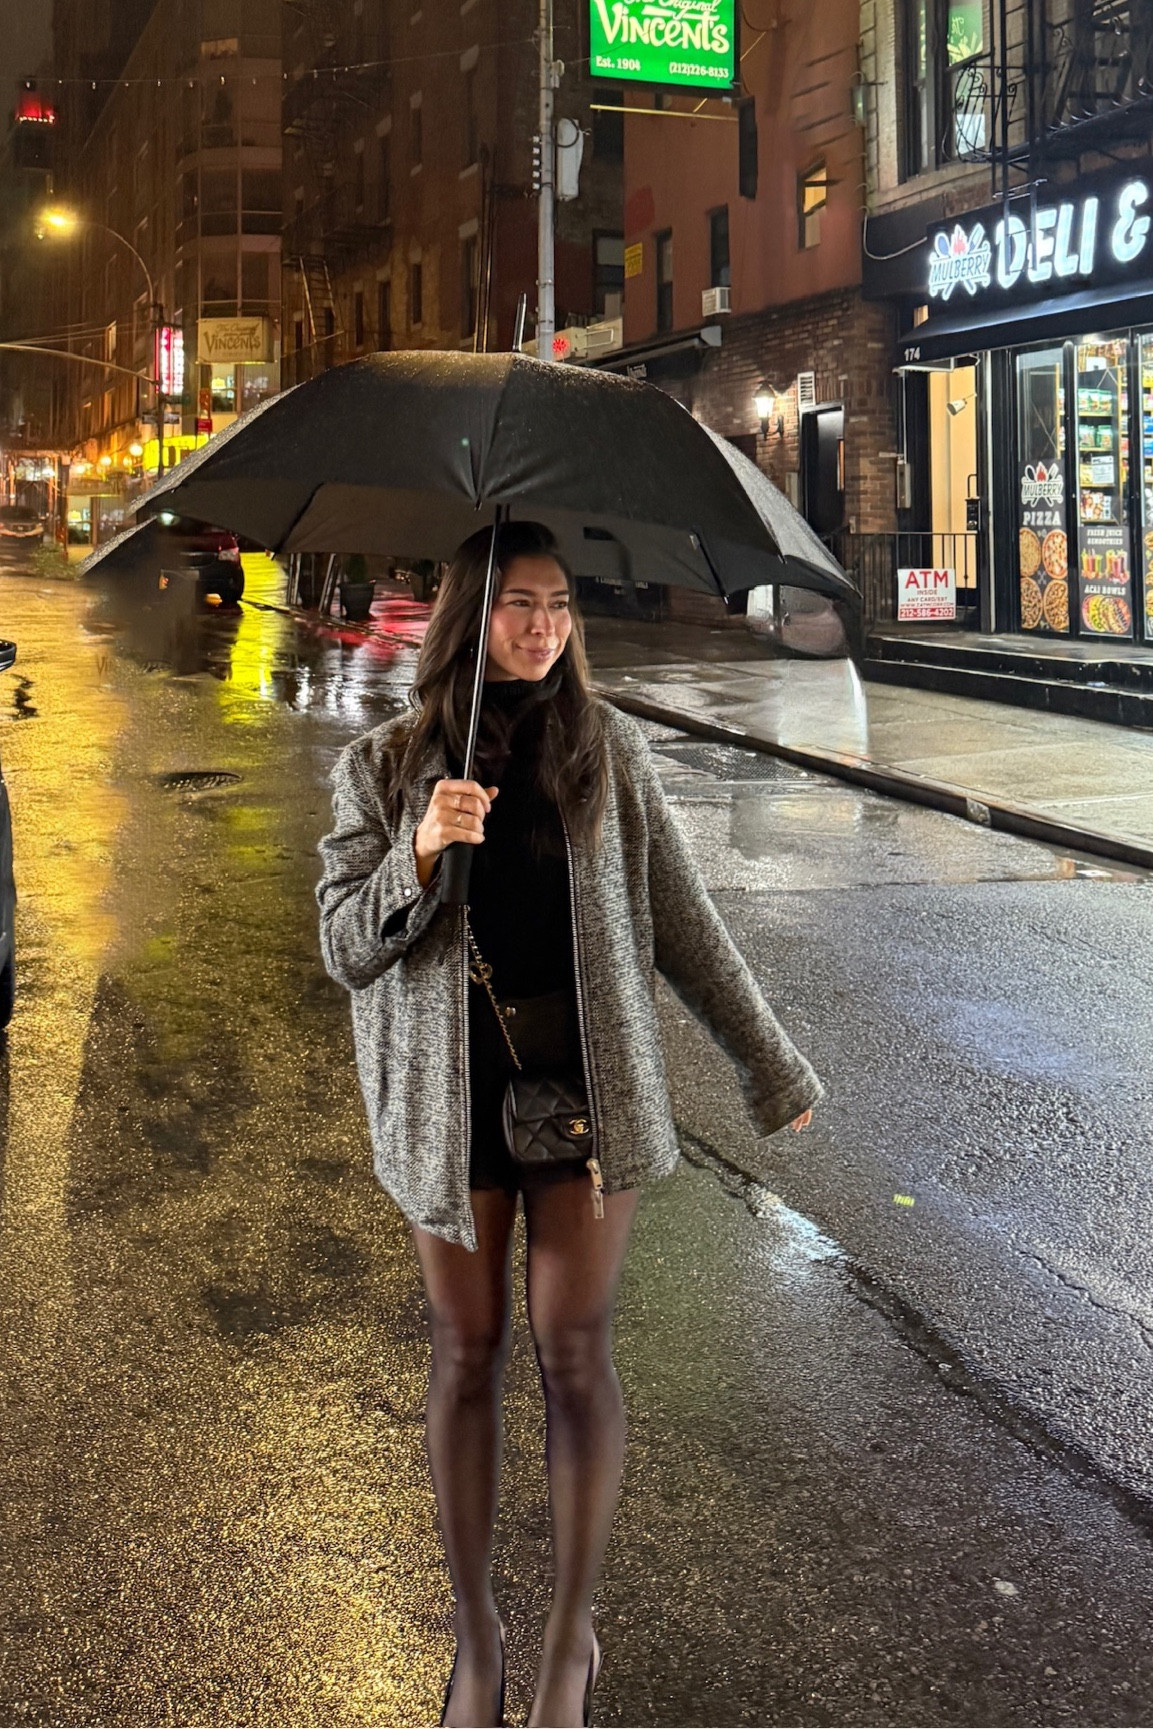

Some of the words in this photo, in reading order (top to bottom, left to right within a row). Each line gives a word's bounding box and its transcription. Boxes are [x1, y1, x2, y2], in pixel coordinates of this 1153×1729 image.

[595, 55, 615, 68] Est.
[616, 58, 641, 71] 1904
[995, 197, 1099, 289] DELI
[1112, 181, 1151, 262] &
[930, 253, 989, 283] MULBERRY
[904, 346, 920, 361] 174
[1022, 511, 1062, 526] PIZZA
[905, 570, 949, 589] ATM
